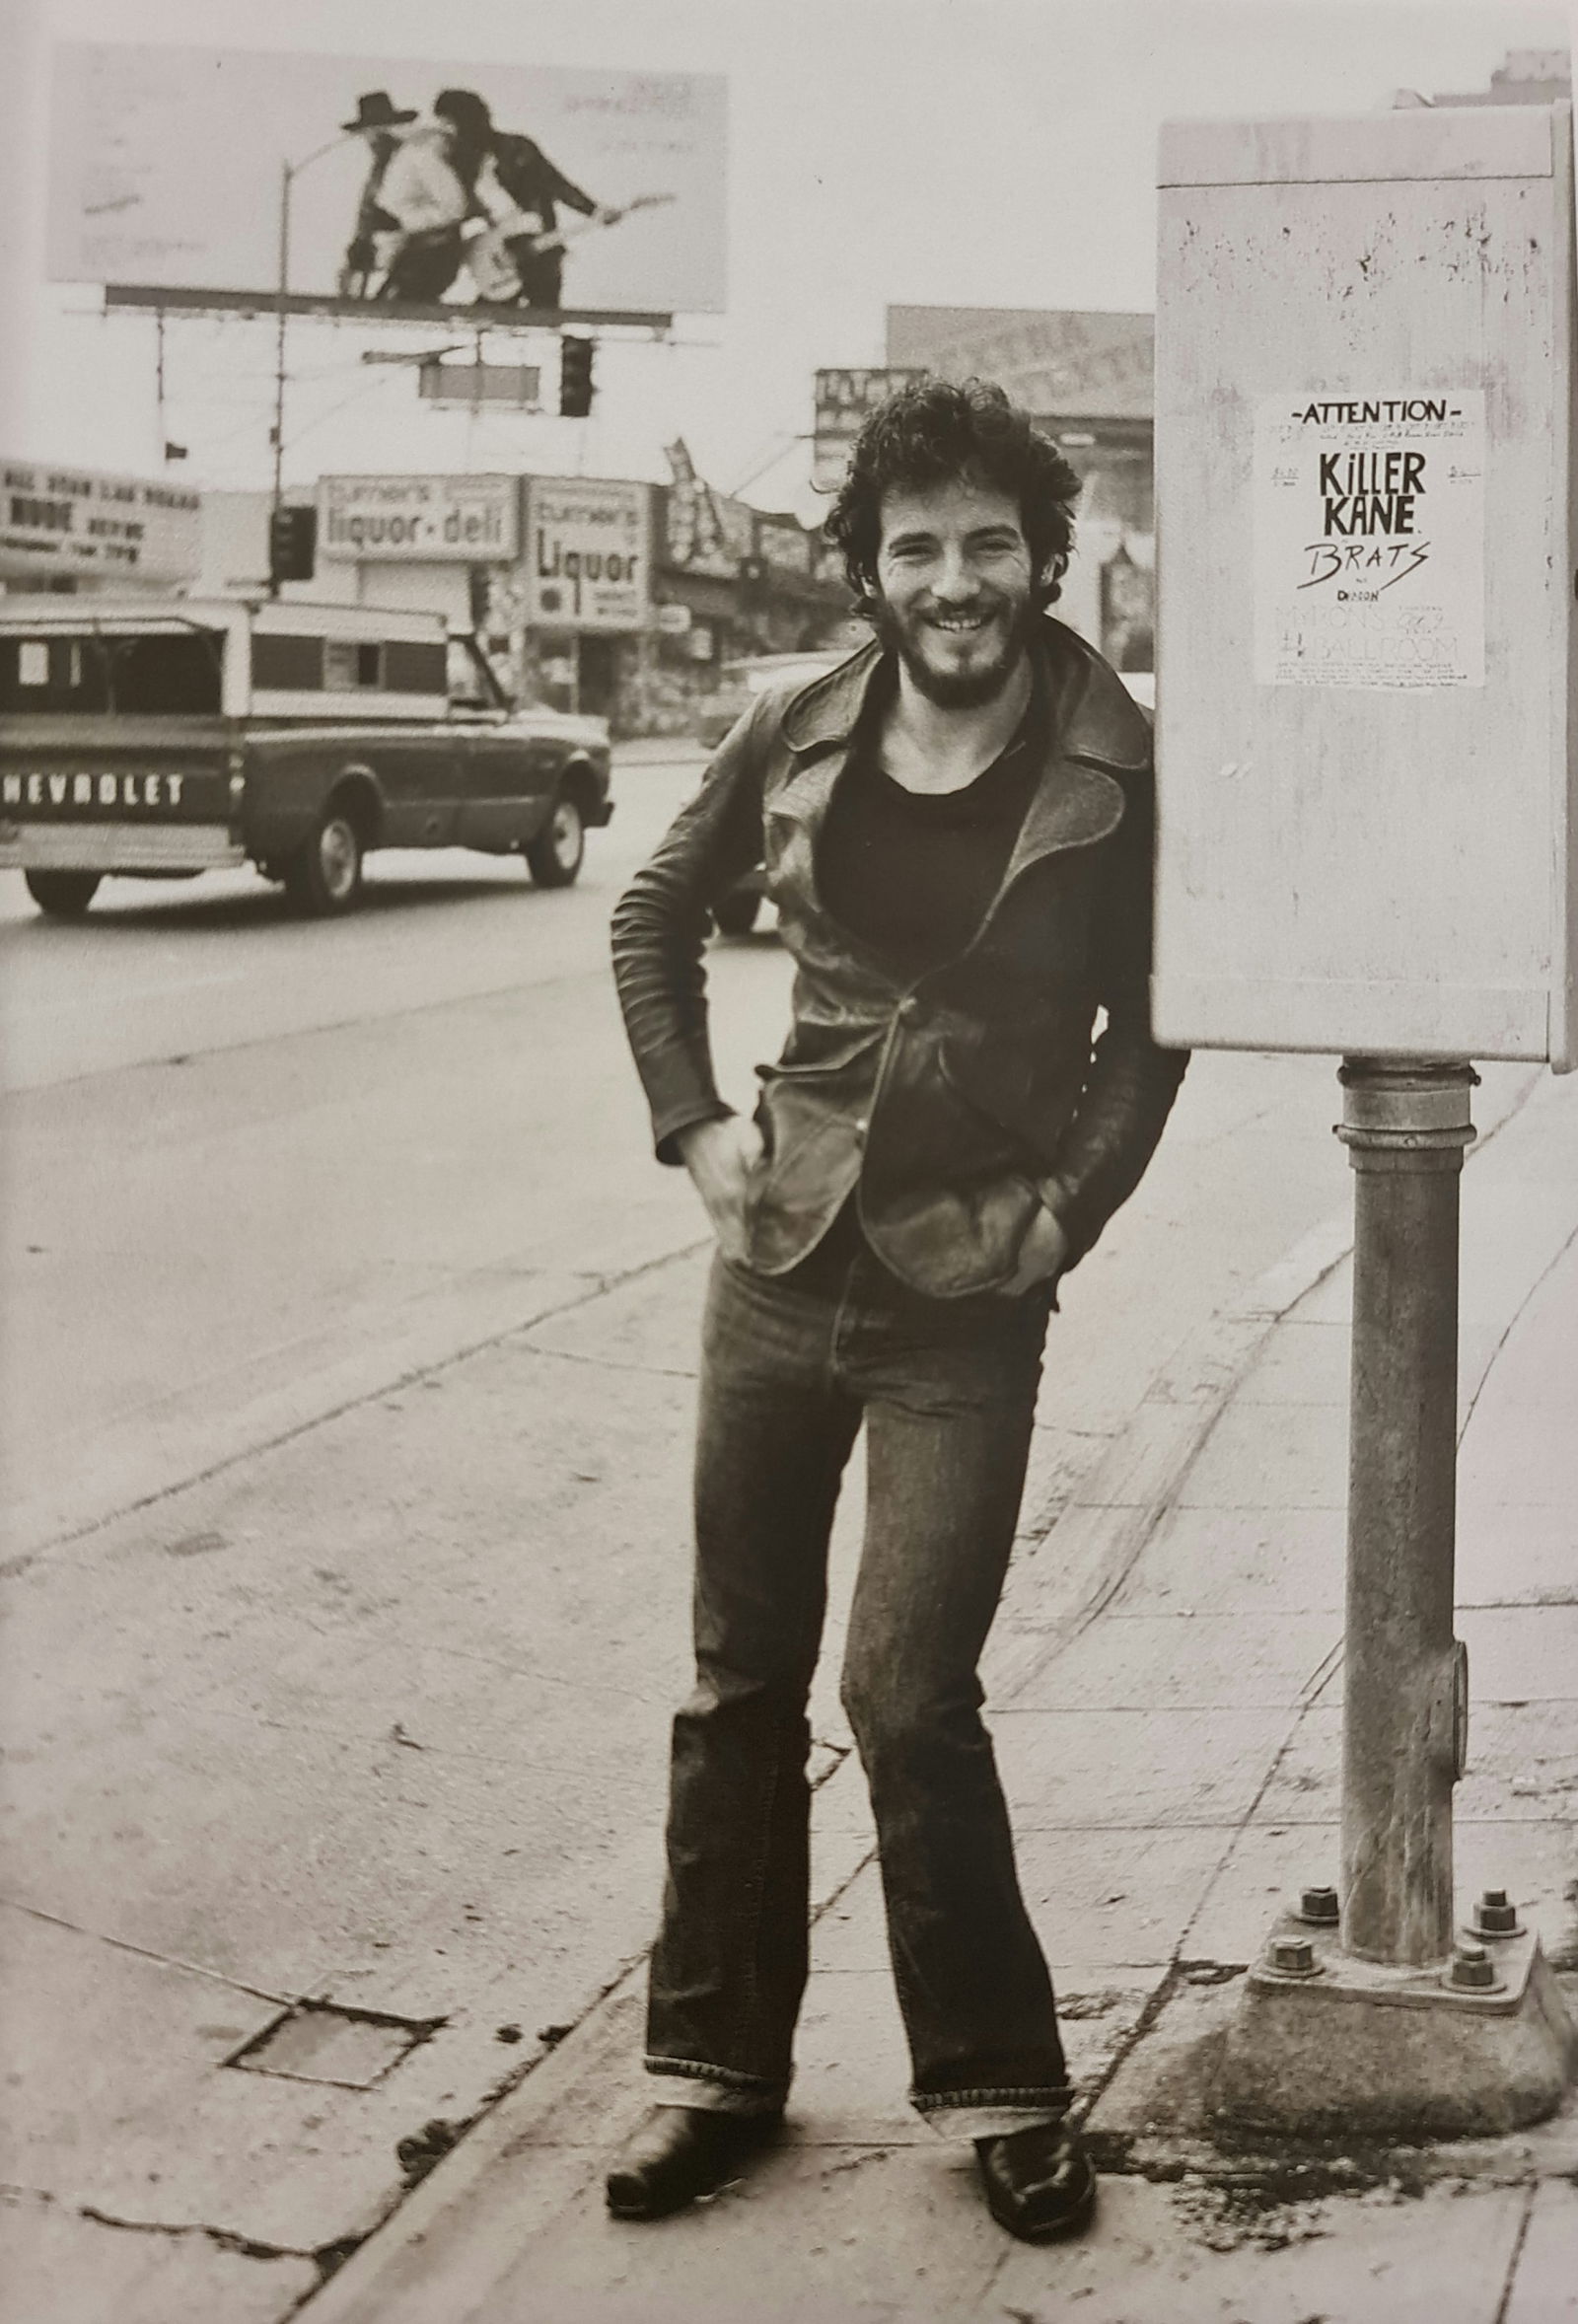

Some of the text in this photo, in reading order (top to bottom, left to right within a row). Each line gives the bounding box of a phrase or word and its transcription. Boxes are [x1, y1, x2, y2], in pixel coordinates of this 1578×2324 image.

[327, 507, 502, 551] liquor deli
[537, 528, 639, 615] Liquor
[1296, 542, 1432, 591] BRATS
[2, 773, 184, 807] HEVROLET
